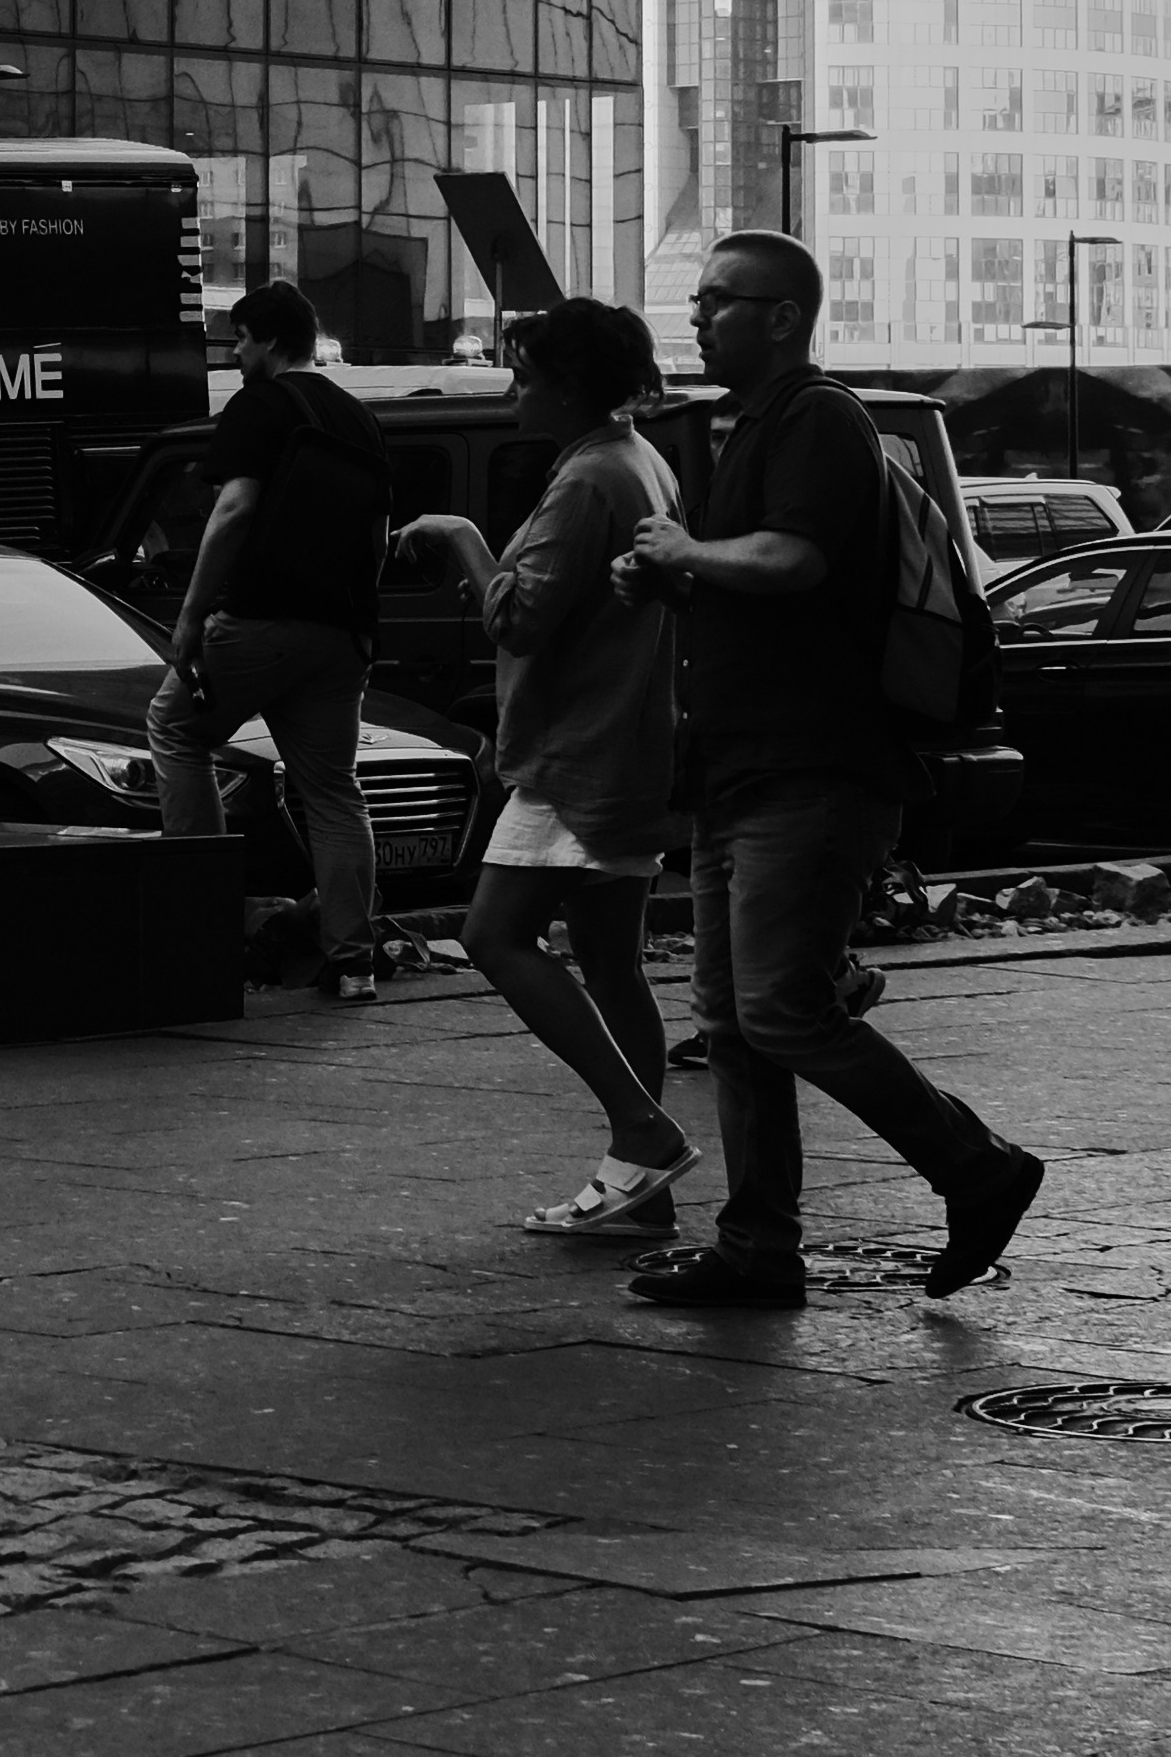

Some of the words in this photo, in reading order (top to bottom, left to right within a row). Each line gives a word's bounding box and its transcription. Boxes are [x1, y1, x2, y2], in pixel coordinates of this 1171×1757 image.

[0, 218, 18, 236] BY
[21, 218, 85, 236] FASHION
[419, 836, 448, 857] 797
